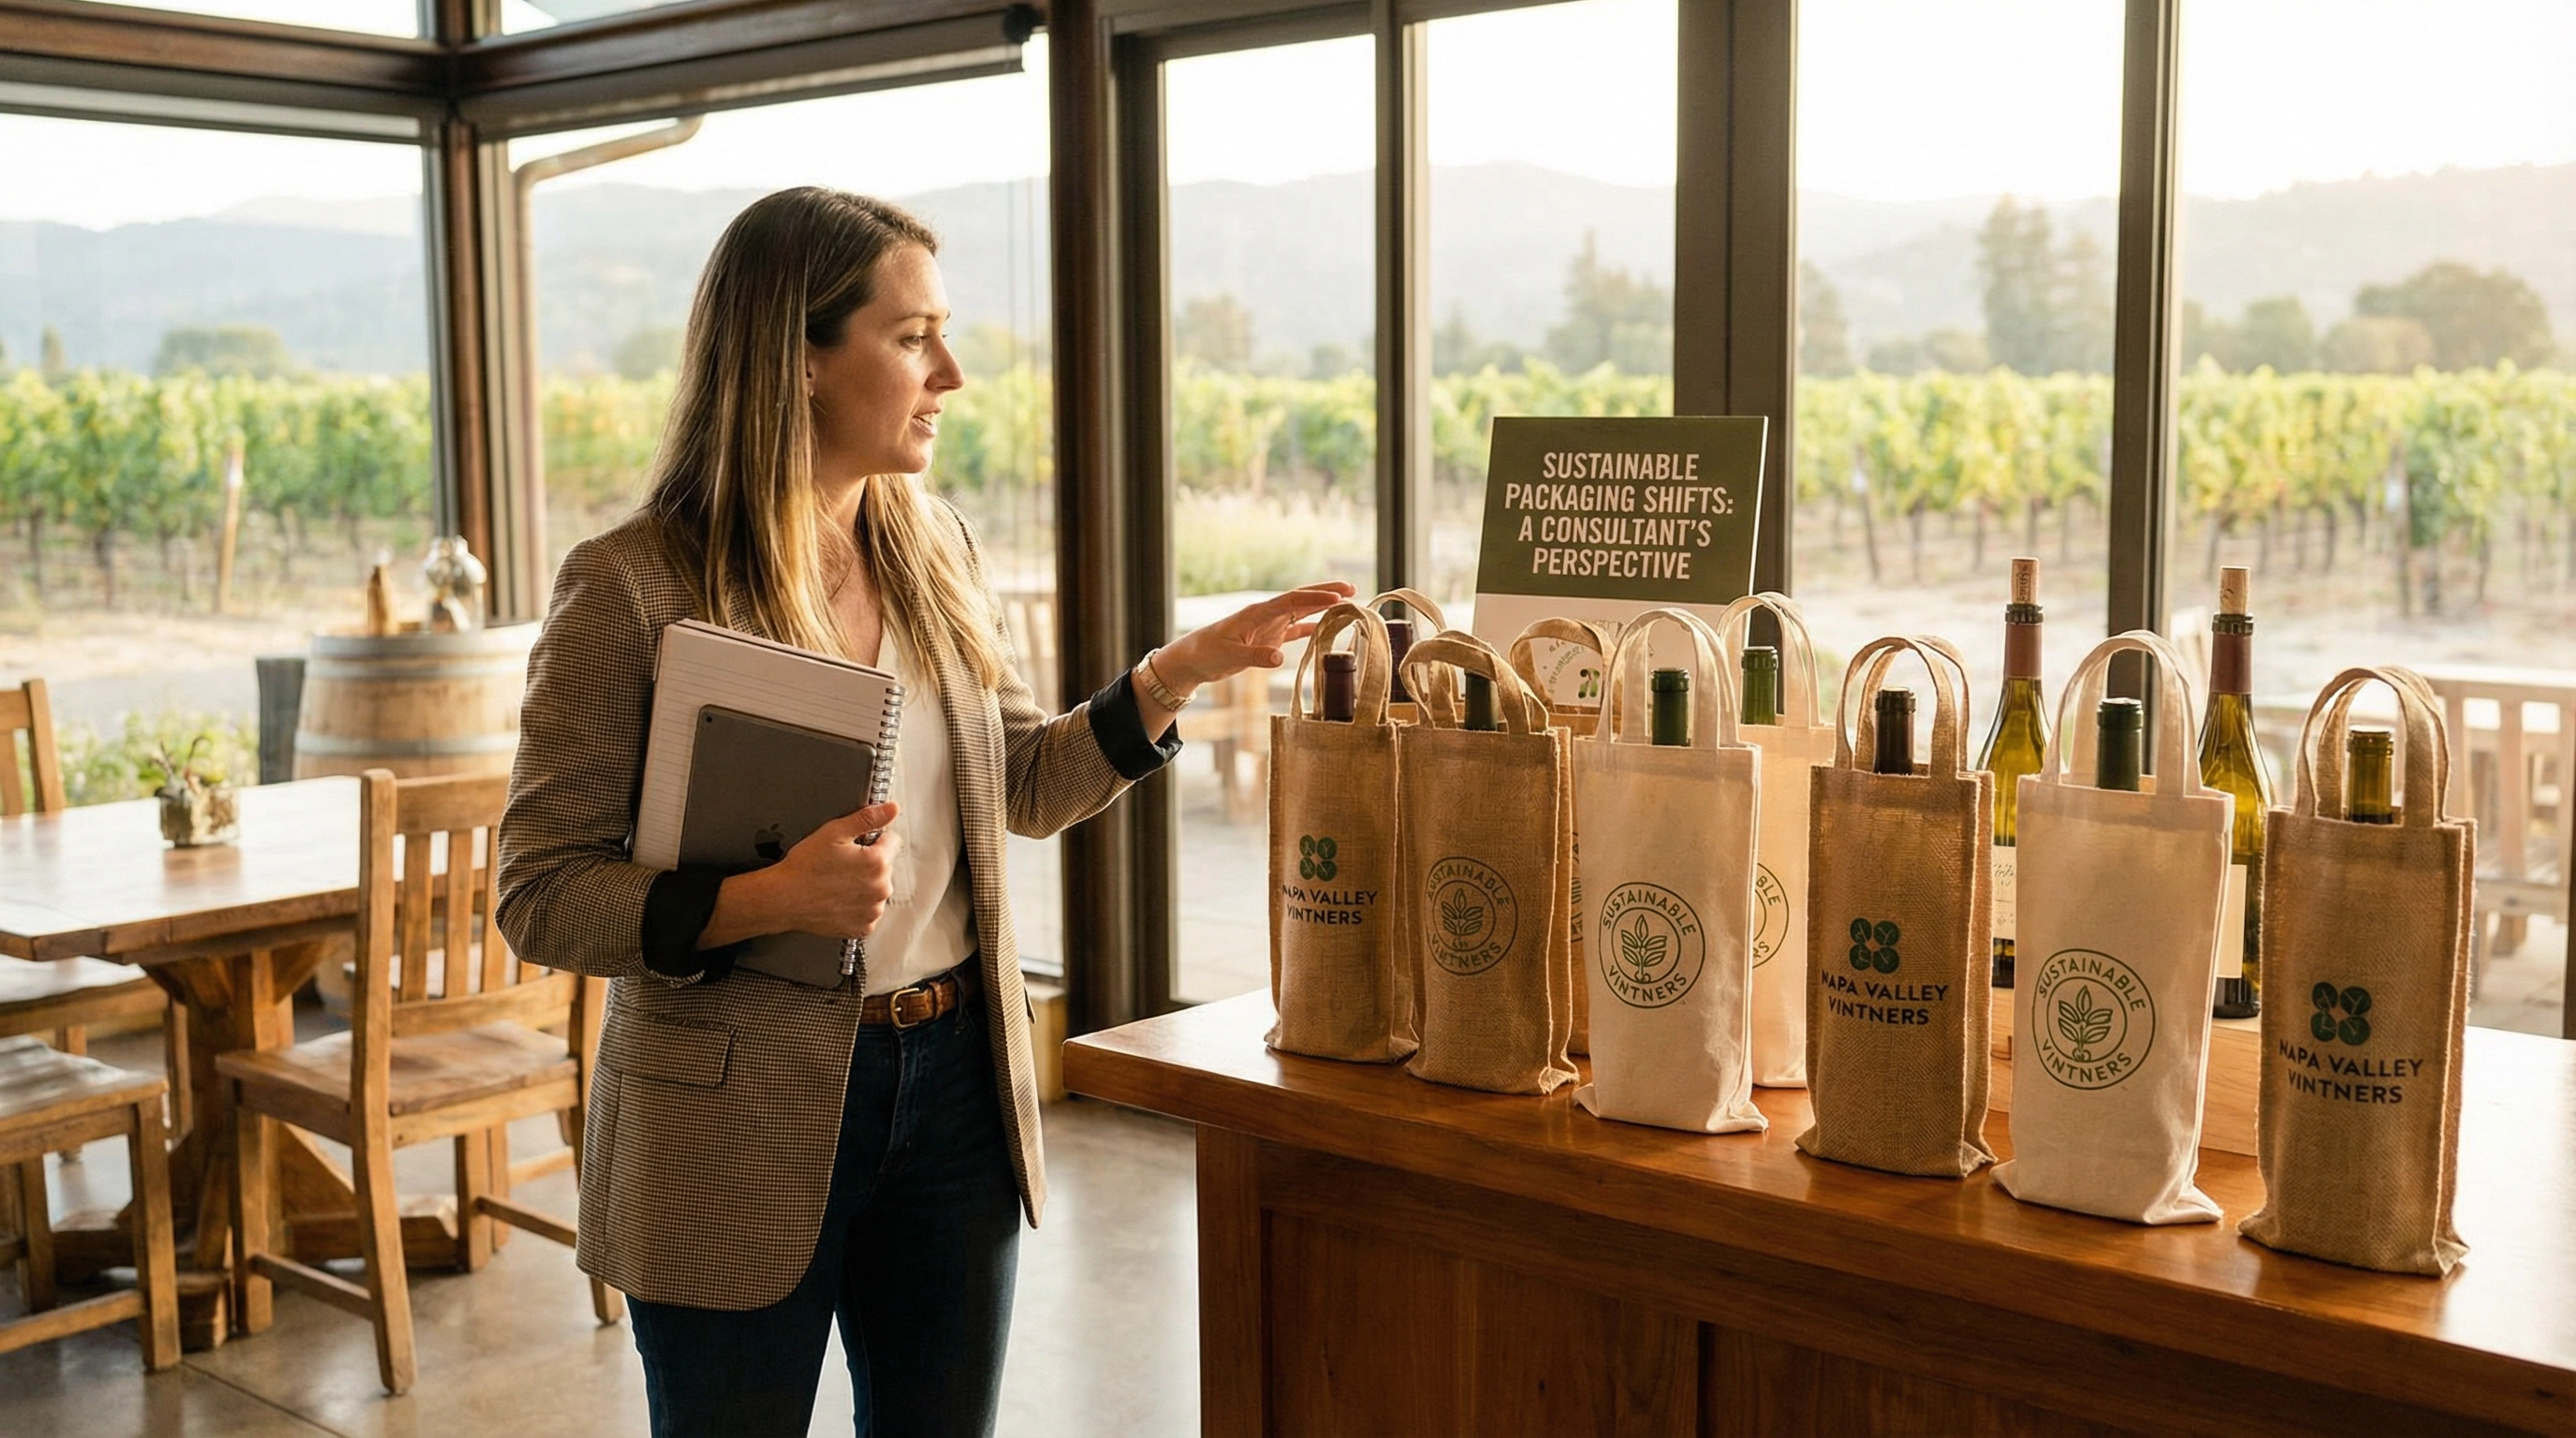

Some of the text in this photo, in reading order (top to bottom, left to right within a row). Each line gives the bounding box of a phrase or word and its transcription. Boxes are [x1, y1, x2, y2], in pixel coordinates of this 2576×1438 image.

[1543, 452, 1699, 480] SUSTAINABLE
[1504, 483, 1734, 515] PACKAGING SHIFTS:
[1517, 516, 1712, 548] A CONSULTANT’S
[1532, 547, 1691, 580] PERSPECTIVE
[1310, 888, 1378, 905] VALLEY
[1603, 888, 1697, 936] SUSTAINABLE
[1286, 903, 1363, 925] VINTNERS
[1608, 964, 1688, 1002] VINTNERS
[1822, 968, 1949, 1002] NAPA VALLEY
[2039, 957, 2146, 1012] SUSTAINABLE
[1828, 995, 1930, 1025] VINTNERS
[2042, 1038, 2132, 1083] VINTNERS
[2279, 1038, 2424, 1078] NAPA VALLEY
[2288, 1068, 2404, 1104] VINTNERS
